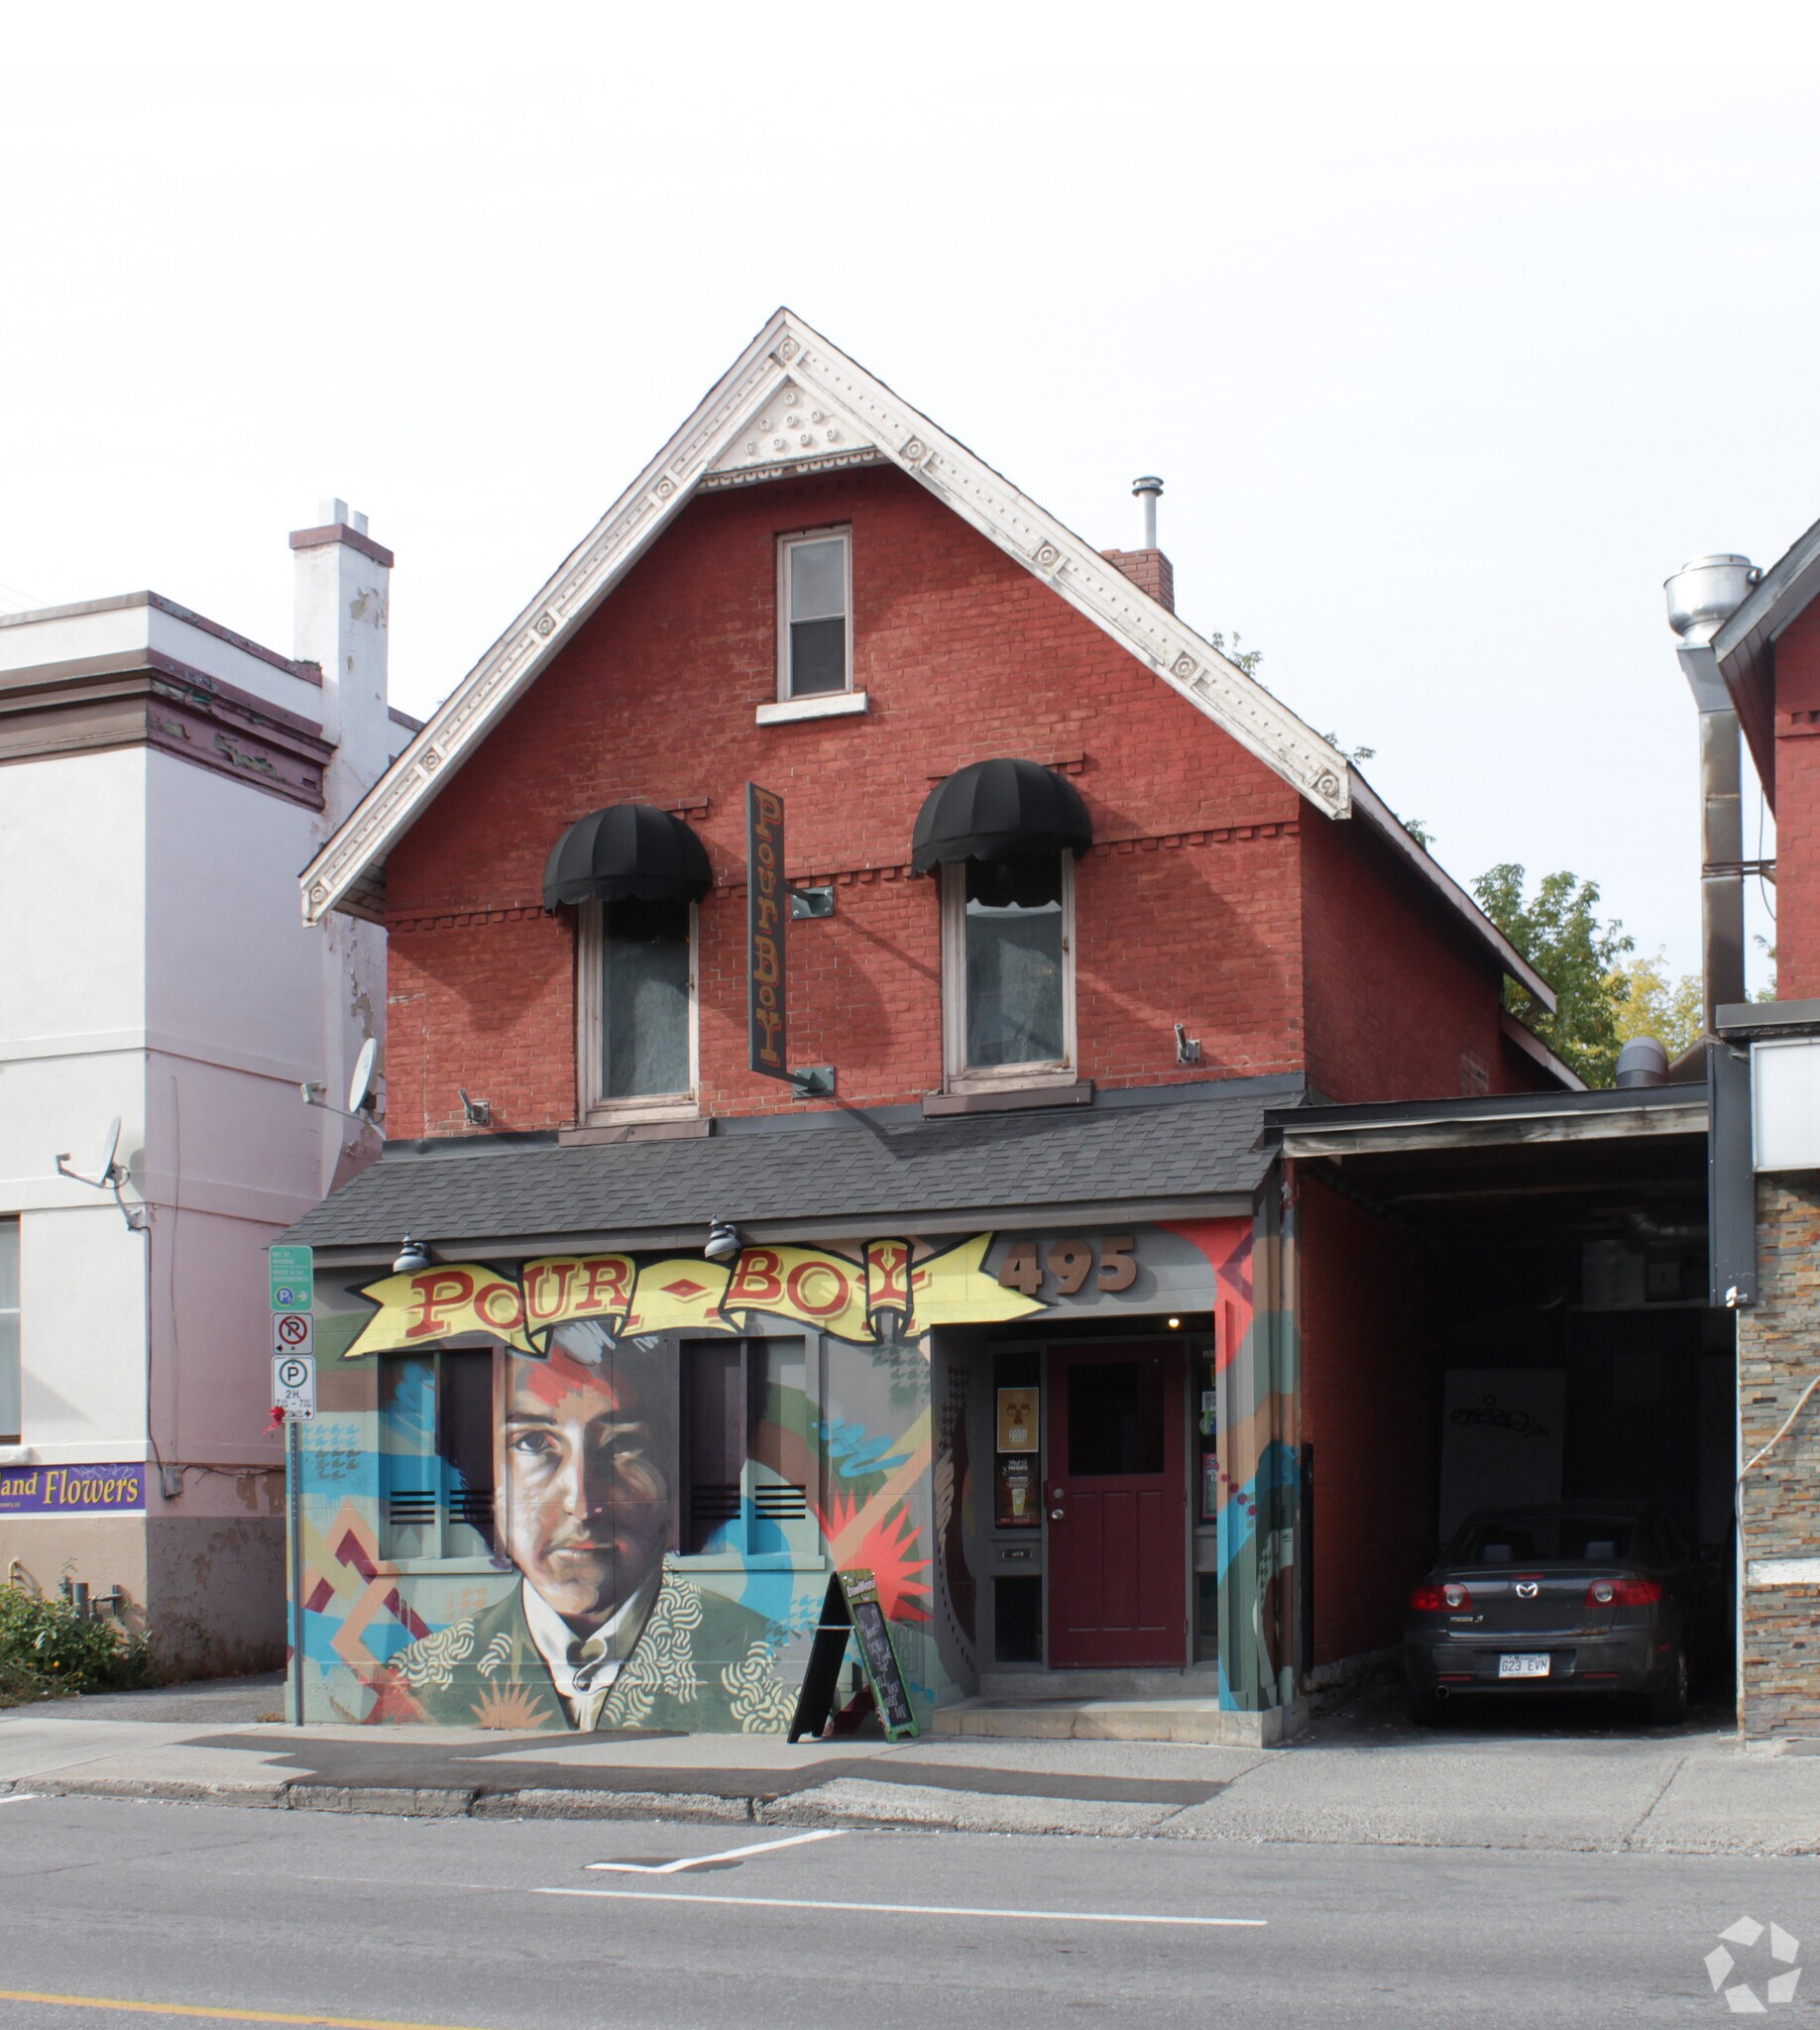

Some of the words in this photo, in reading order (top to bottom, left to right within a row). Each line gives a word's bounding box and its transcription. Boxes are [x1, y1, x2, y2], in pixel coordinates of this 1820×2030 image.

[998, 1236, 1137, 1296] 495
[405, 1259, 640, 1338] POUR
[706, 1246, 926, 1330] BOY
[287, 1367, 298, 1382] P
[0, 1471, 39, 1497] and
[43, 1468, 140, 1506] Flowers
[1528, 1659, 1547, 1671] EVN
